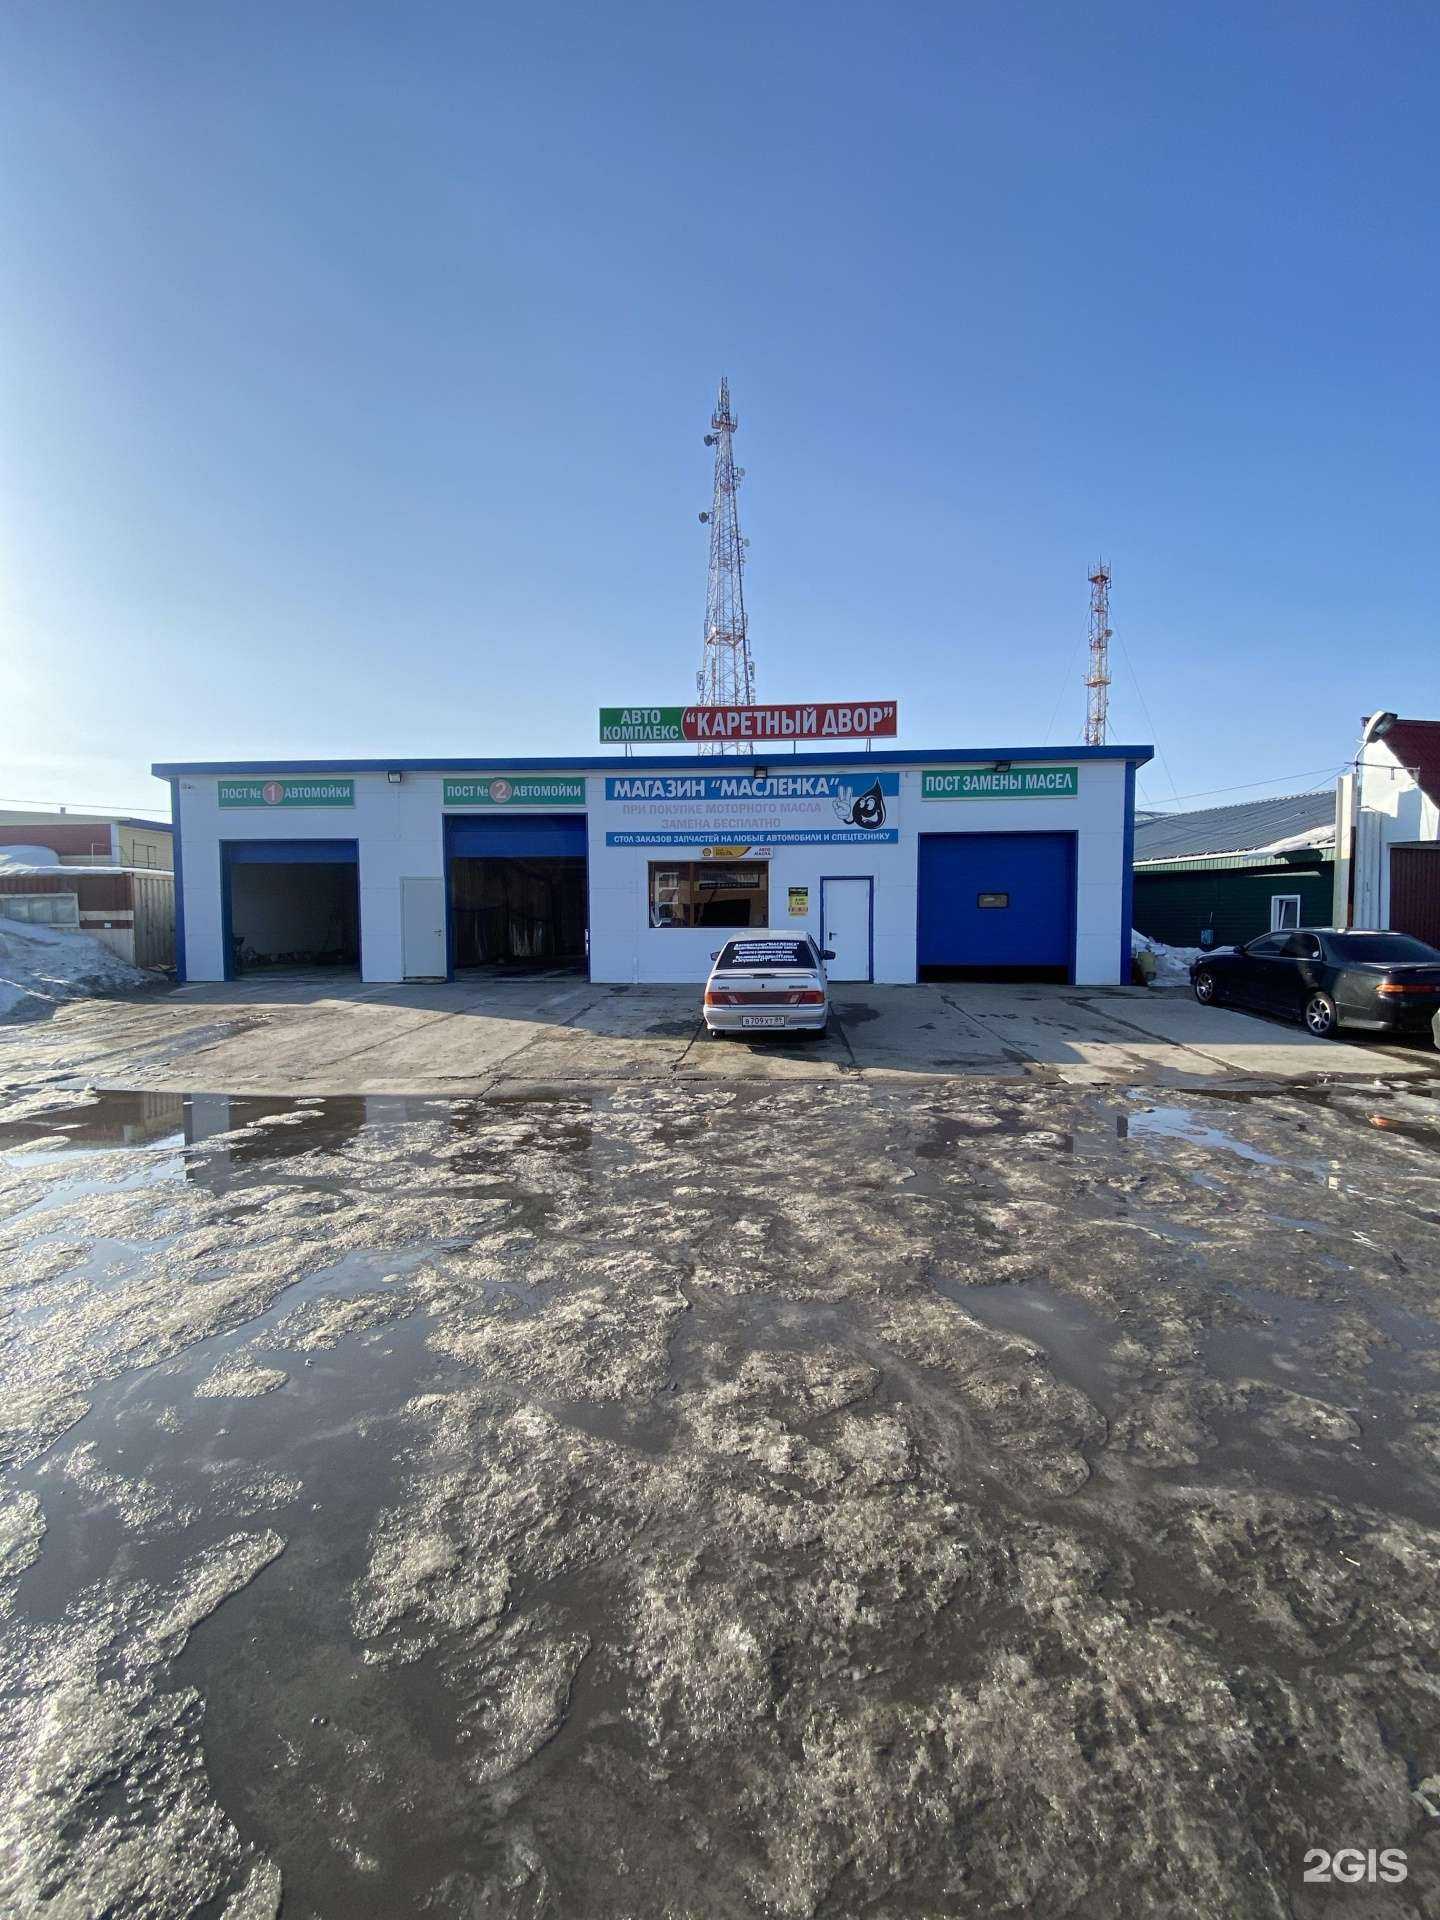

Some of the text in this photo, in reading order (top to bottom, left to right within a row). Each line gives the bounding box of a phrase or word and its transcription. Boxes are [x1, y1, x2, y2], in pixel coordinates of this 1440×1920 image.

[621, 710, 660, 724] АВТО
[686, 707, 893, 736] “КАРЕТНЫЙ ДВОР”
[603, 725, 679, 740] КОМПЛЕКС
[614, 780, 705, 797] МАГАЗИН
[926, 773, 1072, 791] ПОСТ ЗАМЕНЫ МАСЕЛ
[222, 788, 248, 798] ПОСТ
[284, 785, 350, 798] АВТОМОЙКИ
[447, 786, 473, 797] ПОСТ
[495, 782, 506, 799] 2
[513, 784, 581, 797] АВТОМОЙКИ
[623, 802, 822, 815] ПРИ ПОКУПКЕ МОТОРНОГО МАСЛА
[661, 817, 781, 829] ЗАМЕНА БЕСПЛАТНО
[614, 835, 634, 843] СТОЛ
[635, 835, 672, 843] ЗАКАЗОВ
[674, 833, 720, 843] ЗАПЧАСТЕЙ
[721, 834, 732, 842] НА
[734, 834, 765, 842] ЛЮБЫЕ
[766, 833, 822, 842] АВТОМОБИЛИ
[831, 831, 890, 841] СПЕЦТЕХНИКУ
